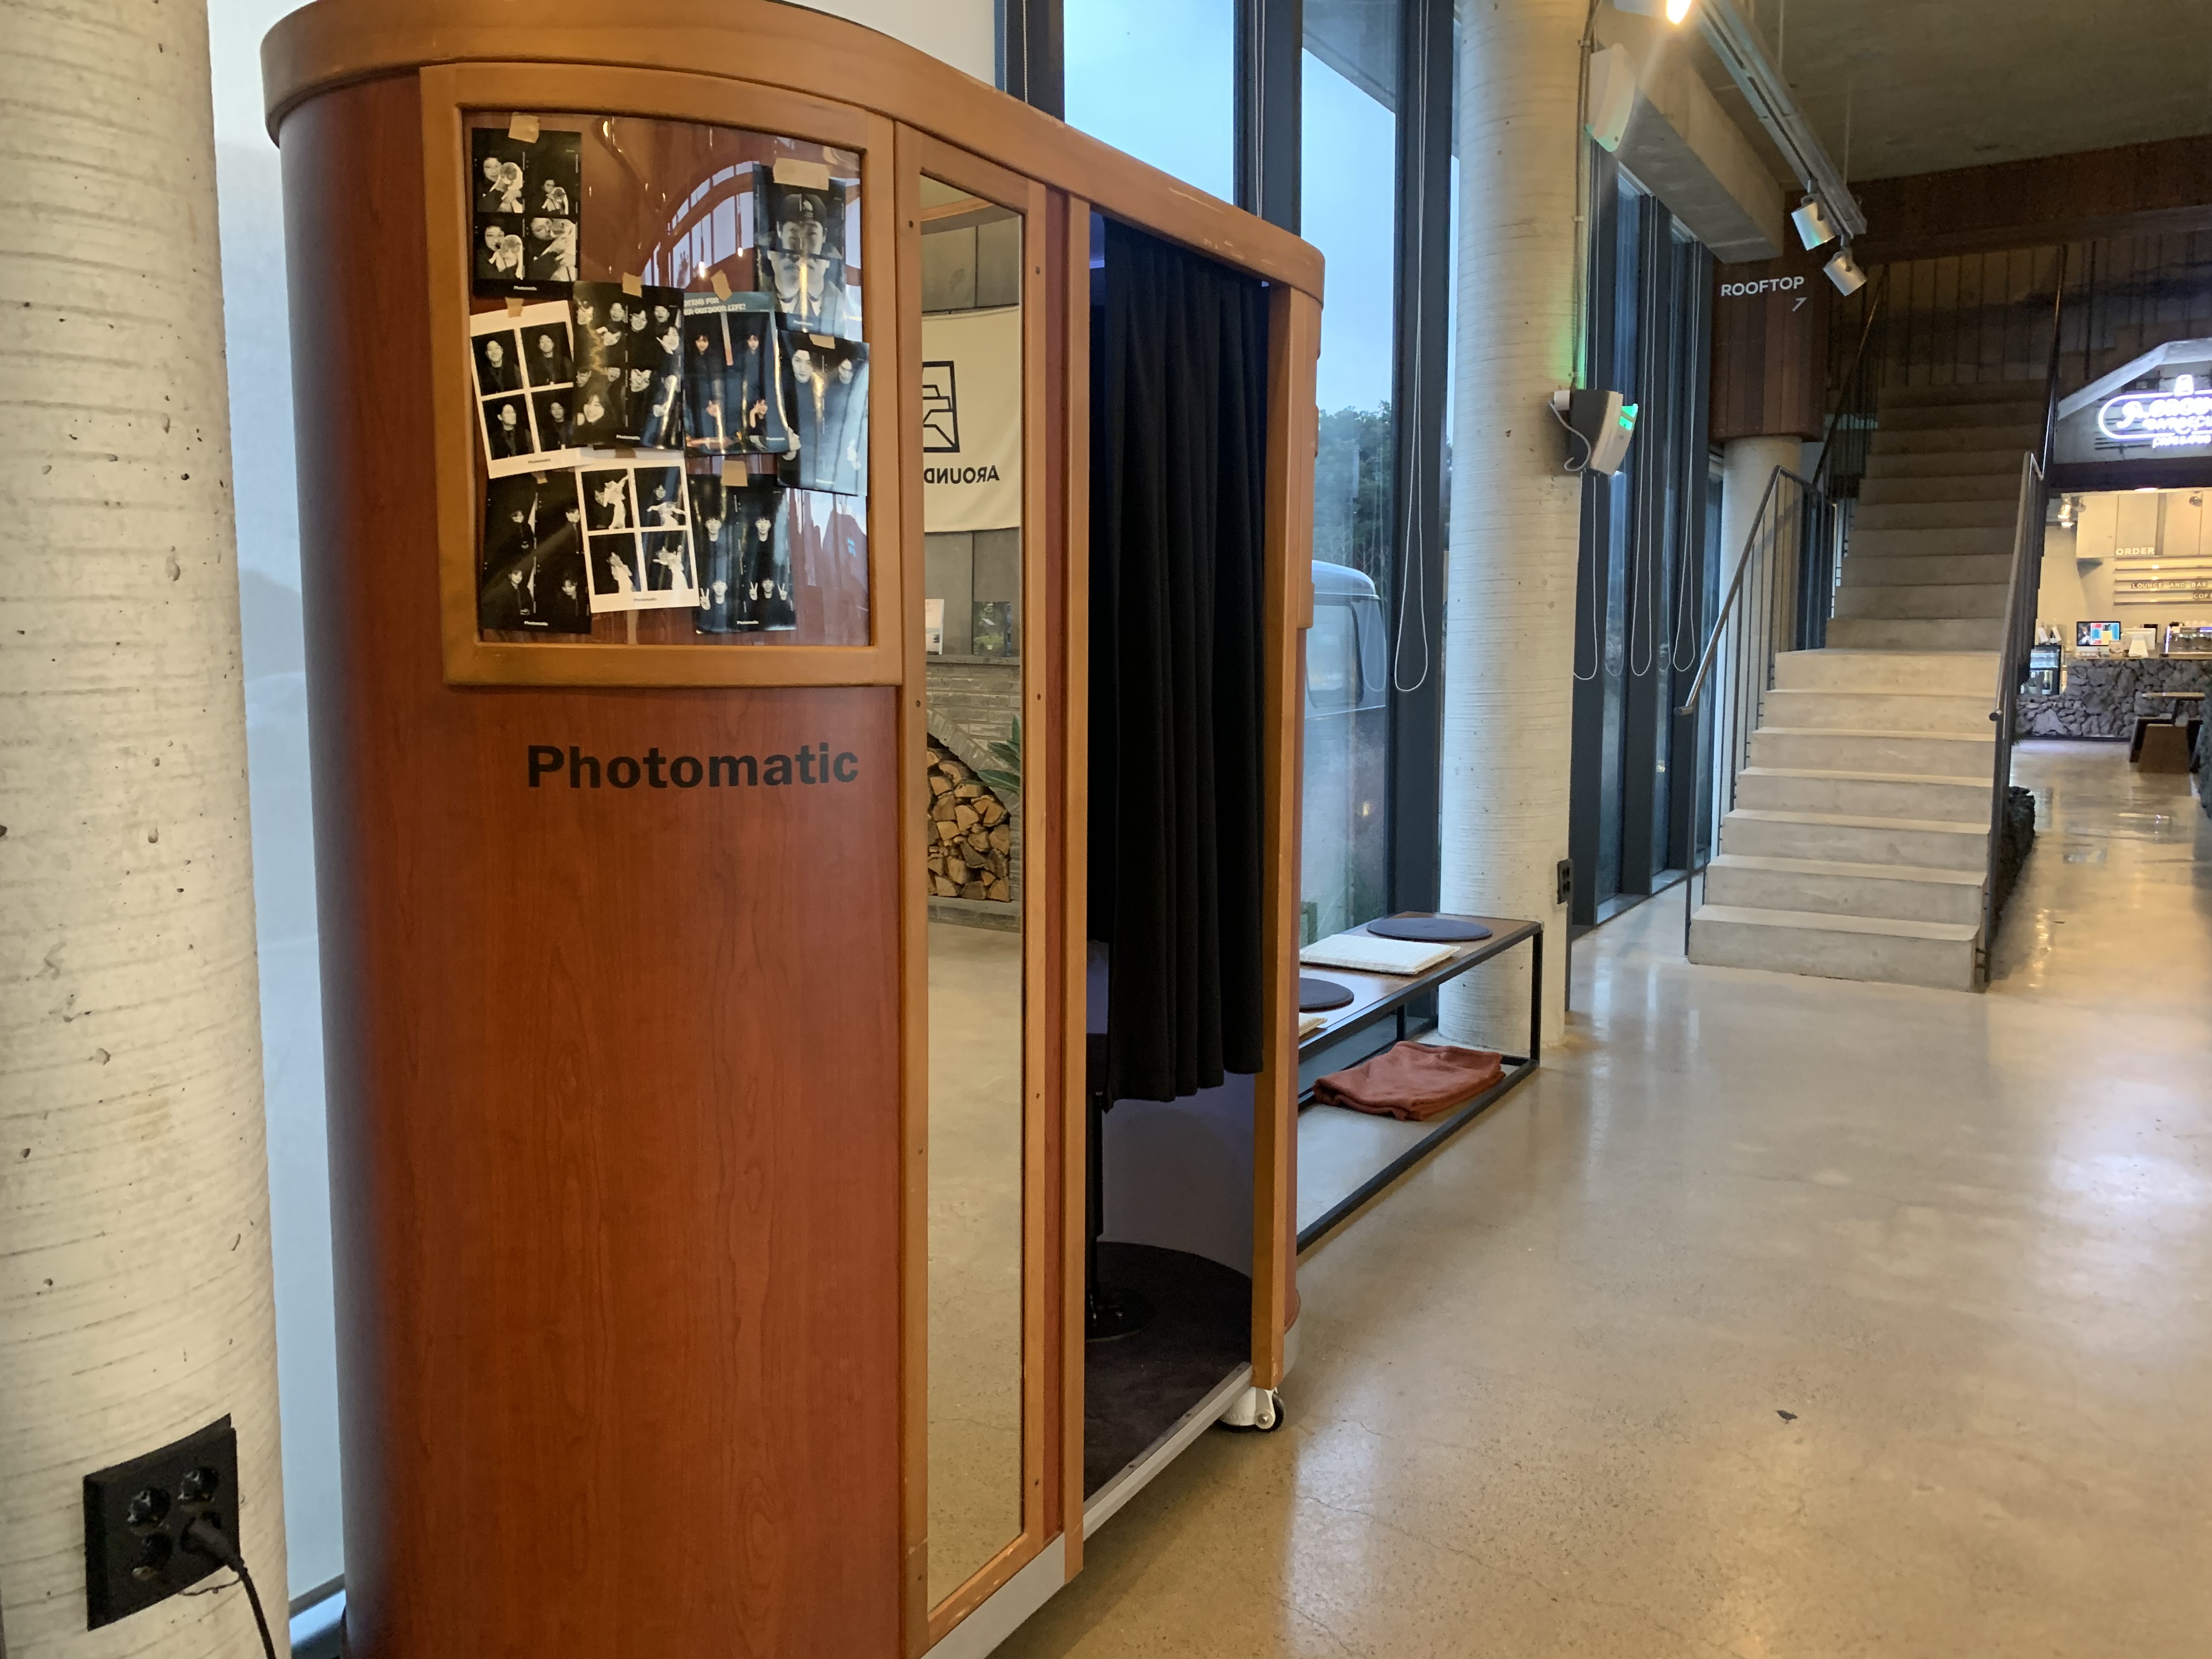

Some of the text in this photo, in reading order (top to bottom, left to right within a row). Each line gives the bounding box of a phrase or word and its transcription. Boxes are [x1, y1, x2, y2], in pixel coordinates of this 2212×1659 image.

[1720, 276, 1804, 297] ROOFTOP
[2115, 547, 2155, 555] ORDER
[527, 742, 859, 789] Photomatic
